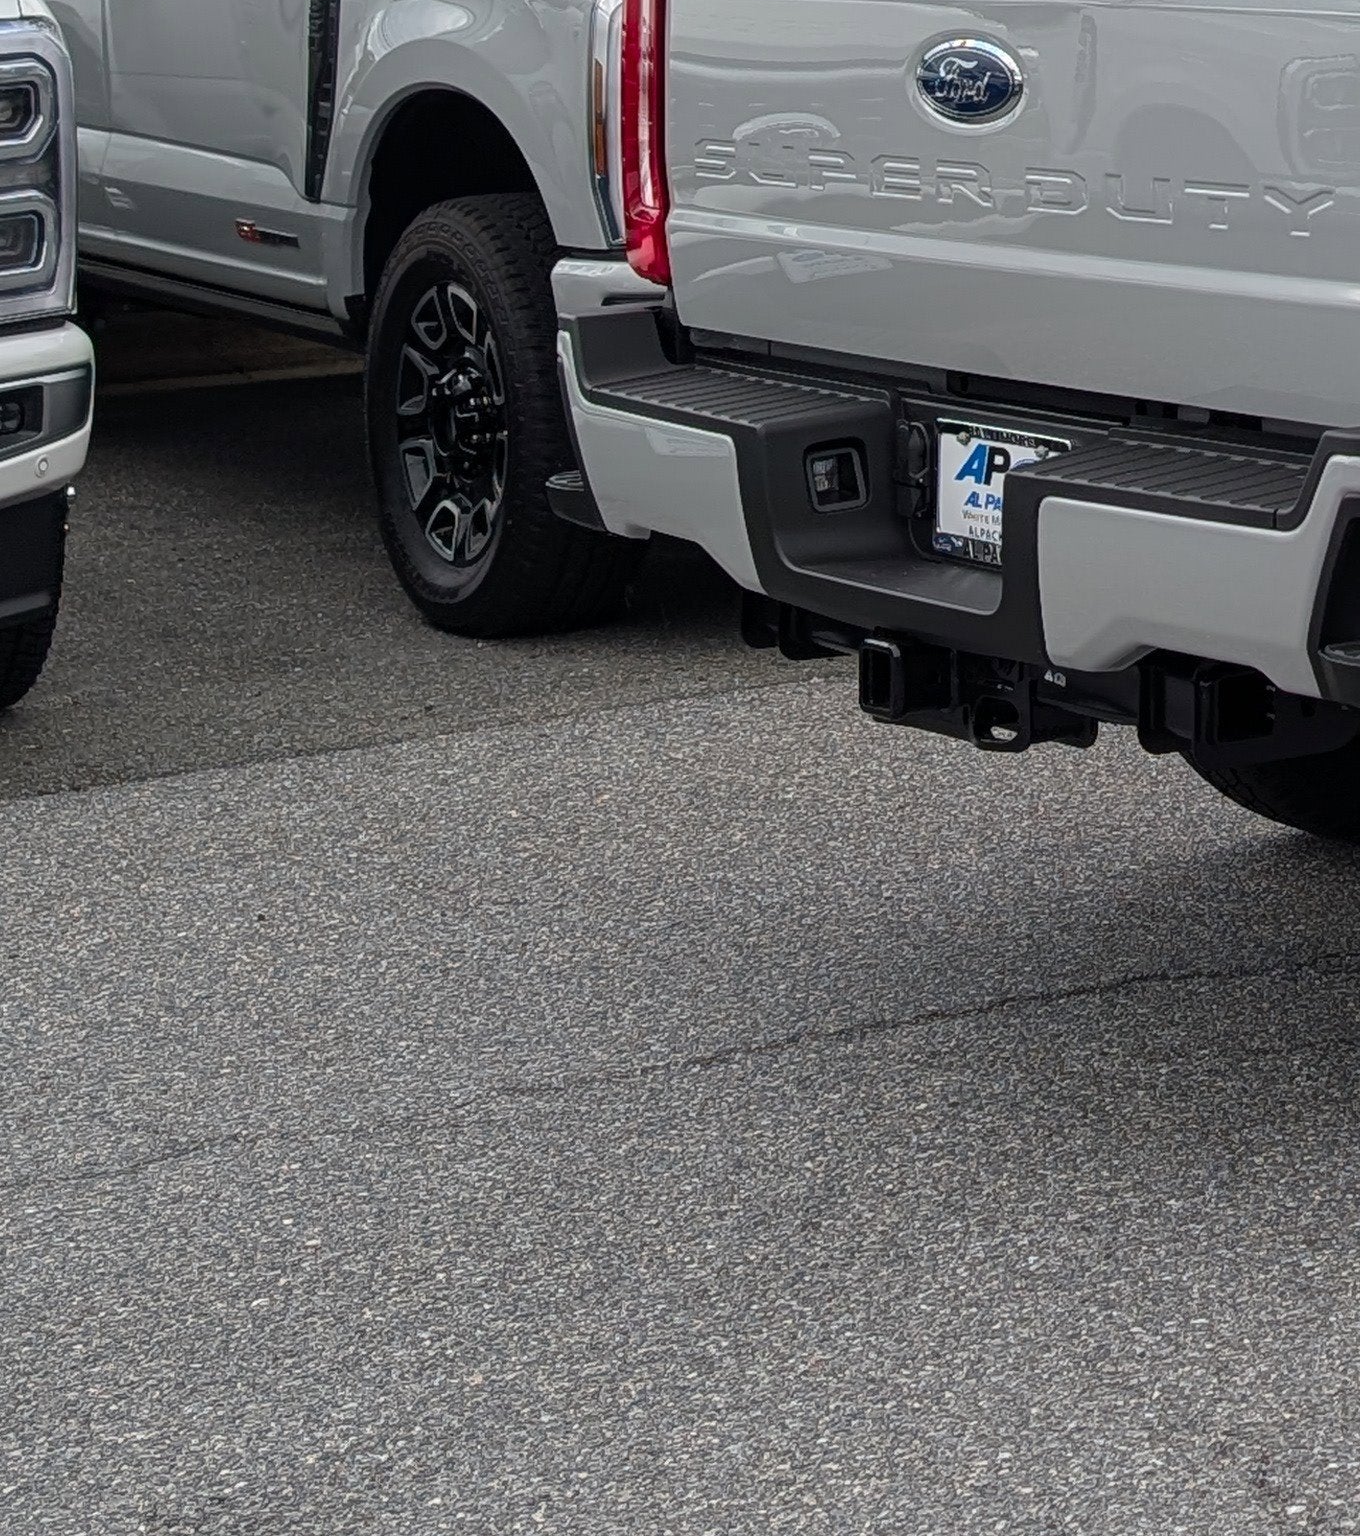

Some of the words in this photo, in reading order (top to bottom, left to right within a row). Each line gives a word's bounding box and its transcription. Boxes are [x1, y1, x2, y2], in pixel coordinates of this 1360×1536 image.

[932, 57, 990, 103] Ford
[695, 138, 993, 207] SUPER
[1024, 166, 1335, 237] DUTY
[954, 443, 1011, 486] AP
